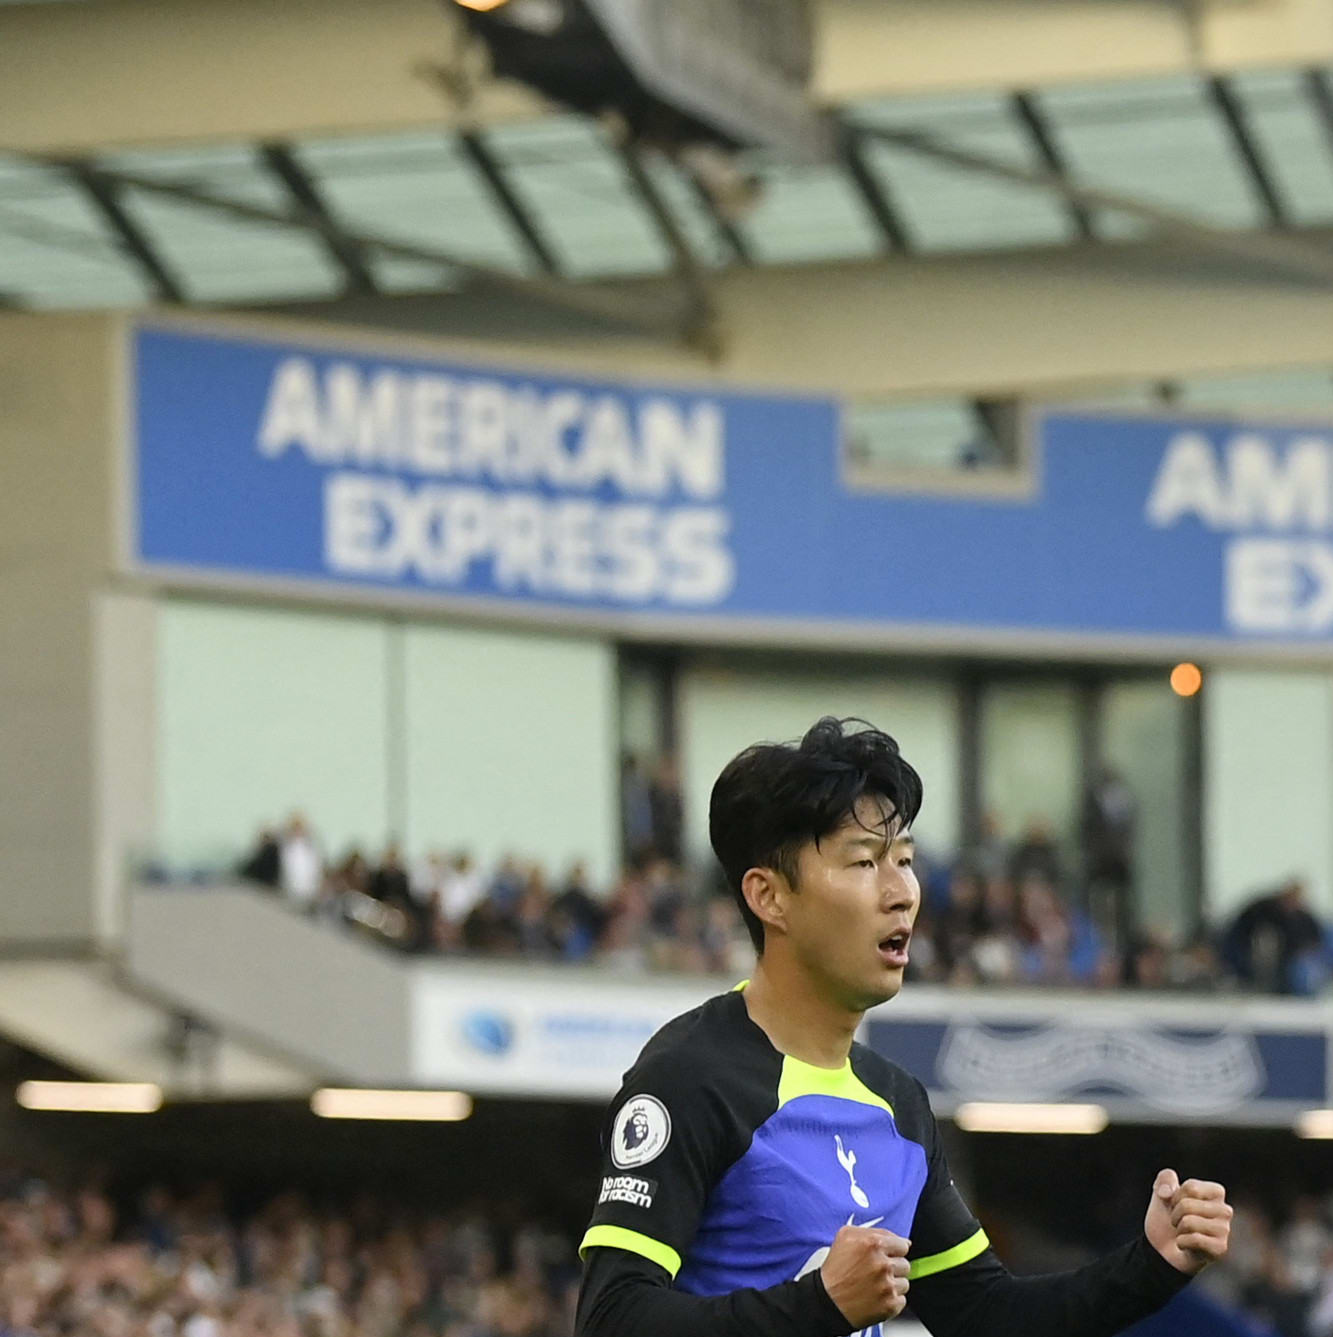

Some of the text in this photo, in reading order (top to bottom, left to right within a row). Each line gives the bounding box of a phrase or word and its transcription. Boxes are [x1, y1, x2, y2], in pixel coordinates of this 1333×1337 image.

[258, 357, 724, 498] AMERICAN
[323, 473, 736, 603] EXPRESS
[613, 1176, 650, 1194] room
